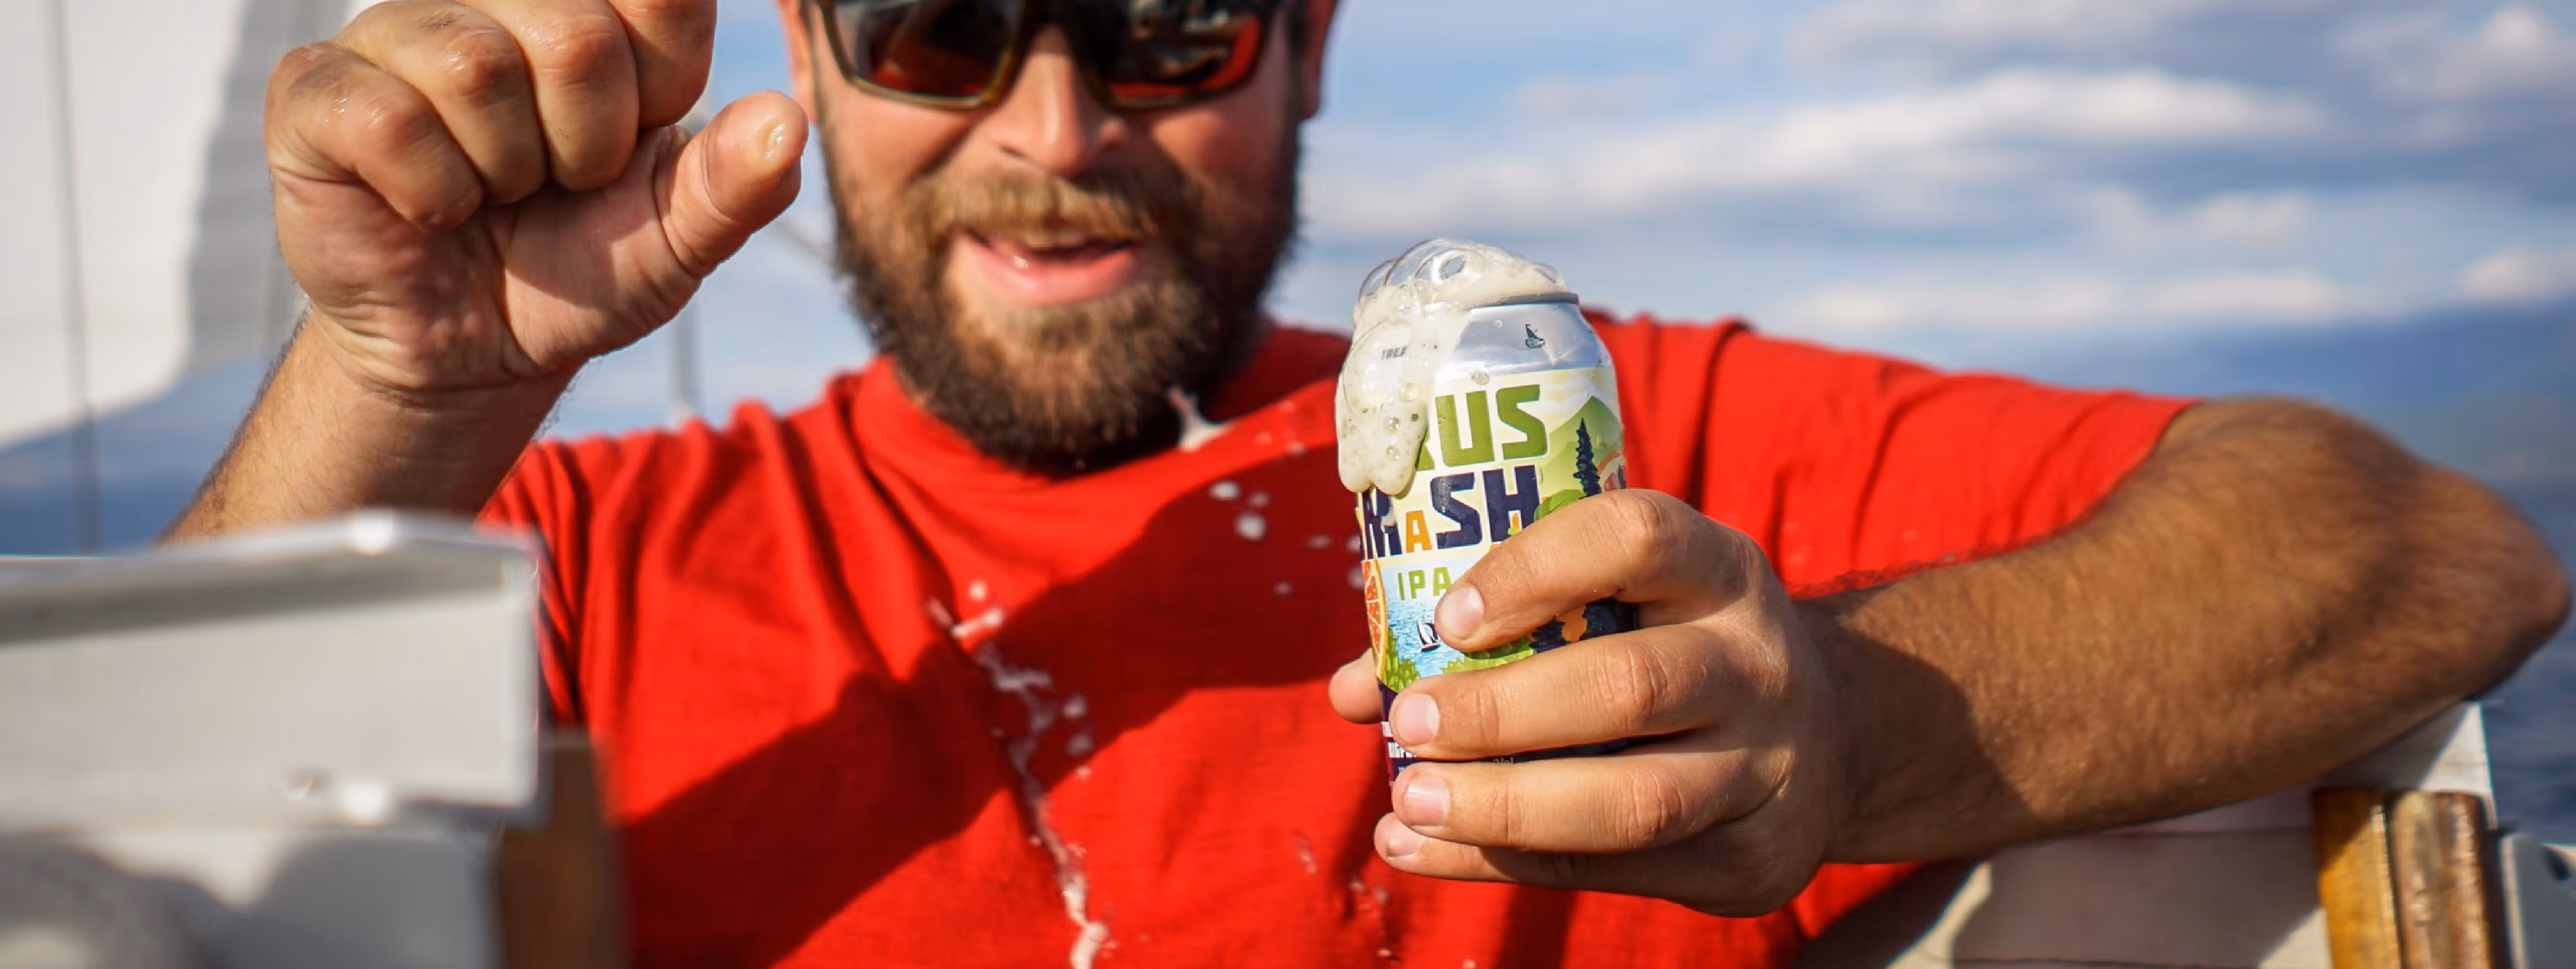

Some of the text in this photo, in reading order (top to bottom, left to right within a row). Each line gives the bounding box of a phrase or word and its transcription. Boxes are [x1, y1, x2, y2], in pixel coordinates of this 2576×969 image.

[1416, 384, 1548, 471] US
[1359, 465, 1541, 561] MASH
[1398, 567, 1452, 600] IPA
